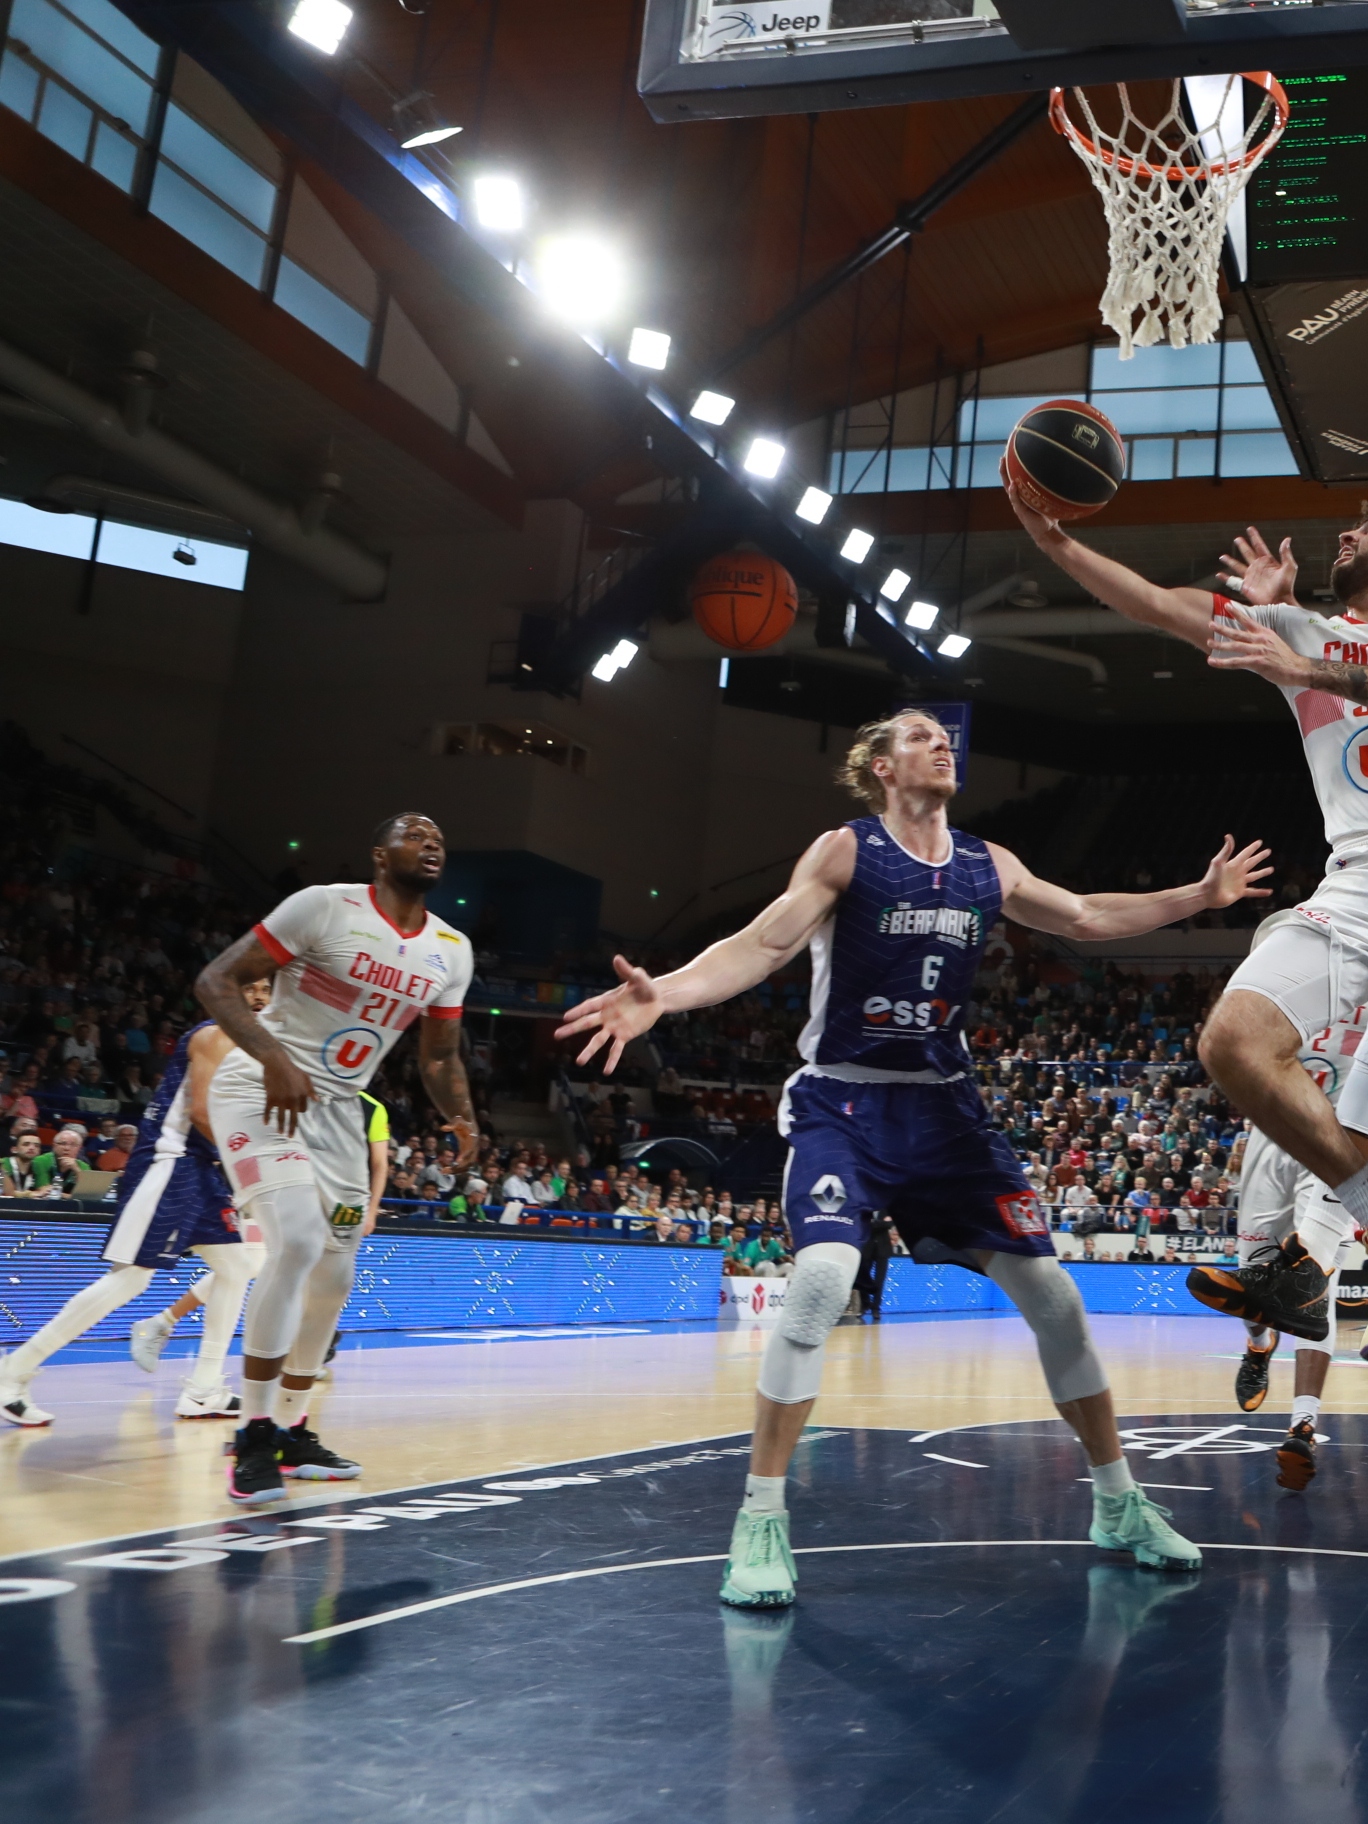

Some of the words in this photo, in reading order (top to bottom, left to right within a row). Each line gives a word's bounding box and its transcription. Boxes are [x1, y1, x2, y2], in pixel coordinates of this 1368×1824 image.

[762, 13, 821, 32] Jeep
[1286, 307, 1340, 341] PAU
[348, 952, 435, 1000] CHOLET
[921, 955, 945, 991] 6
[358, 992, 402, 1028] 21
[335, 1039, 374, 1069] U
[64, 1532, 328, 1571] DE
[277, 1492, 524, 1531] PAU
